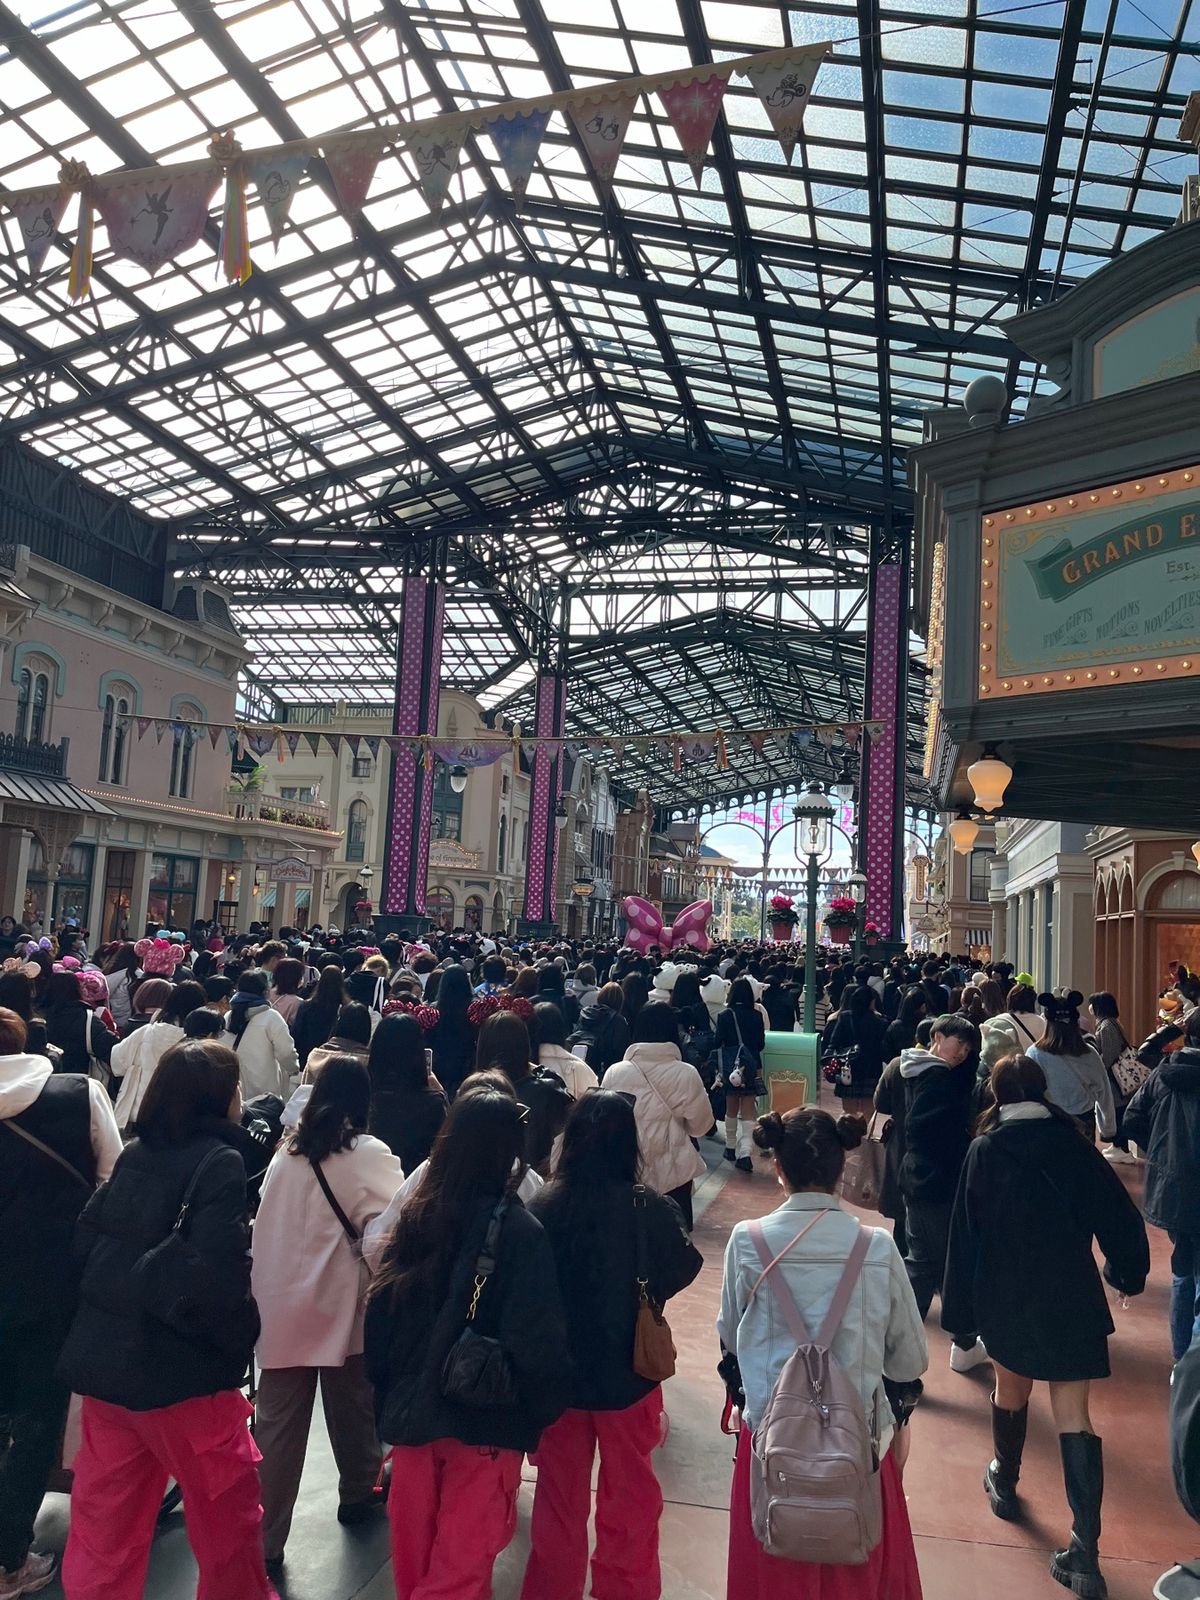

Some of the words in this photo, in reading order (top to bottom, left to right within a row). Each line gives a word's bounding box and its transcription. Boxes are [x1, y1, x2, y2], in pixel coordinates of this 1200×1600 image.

[1062, 523, 1163, 584] GRAND
[1166, 560, 1195, 574] Est.
[1065, 607, 1093, 632] GIFTS
[1096, 600, 1140, 640] NOTIONS
